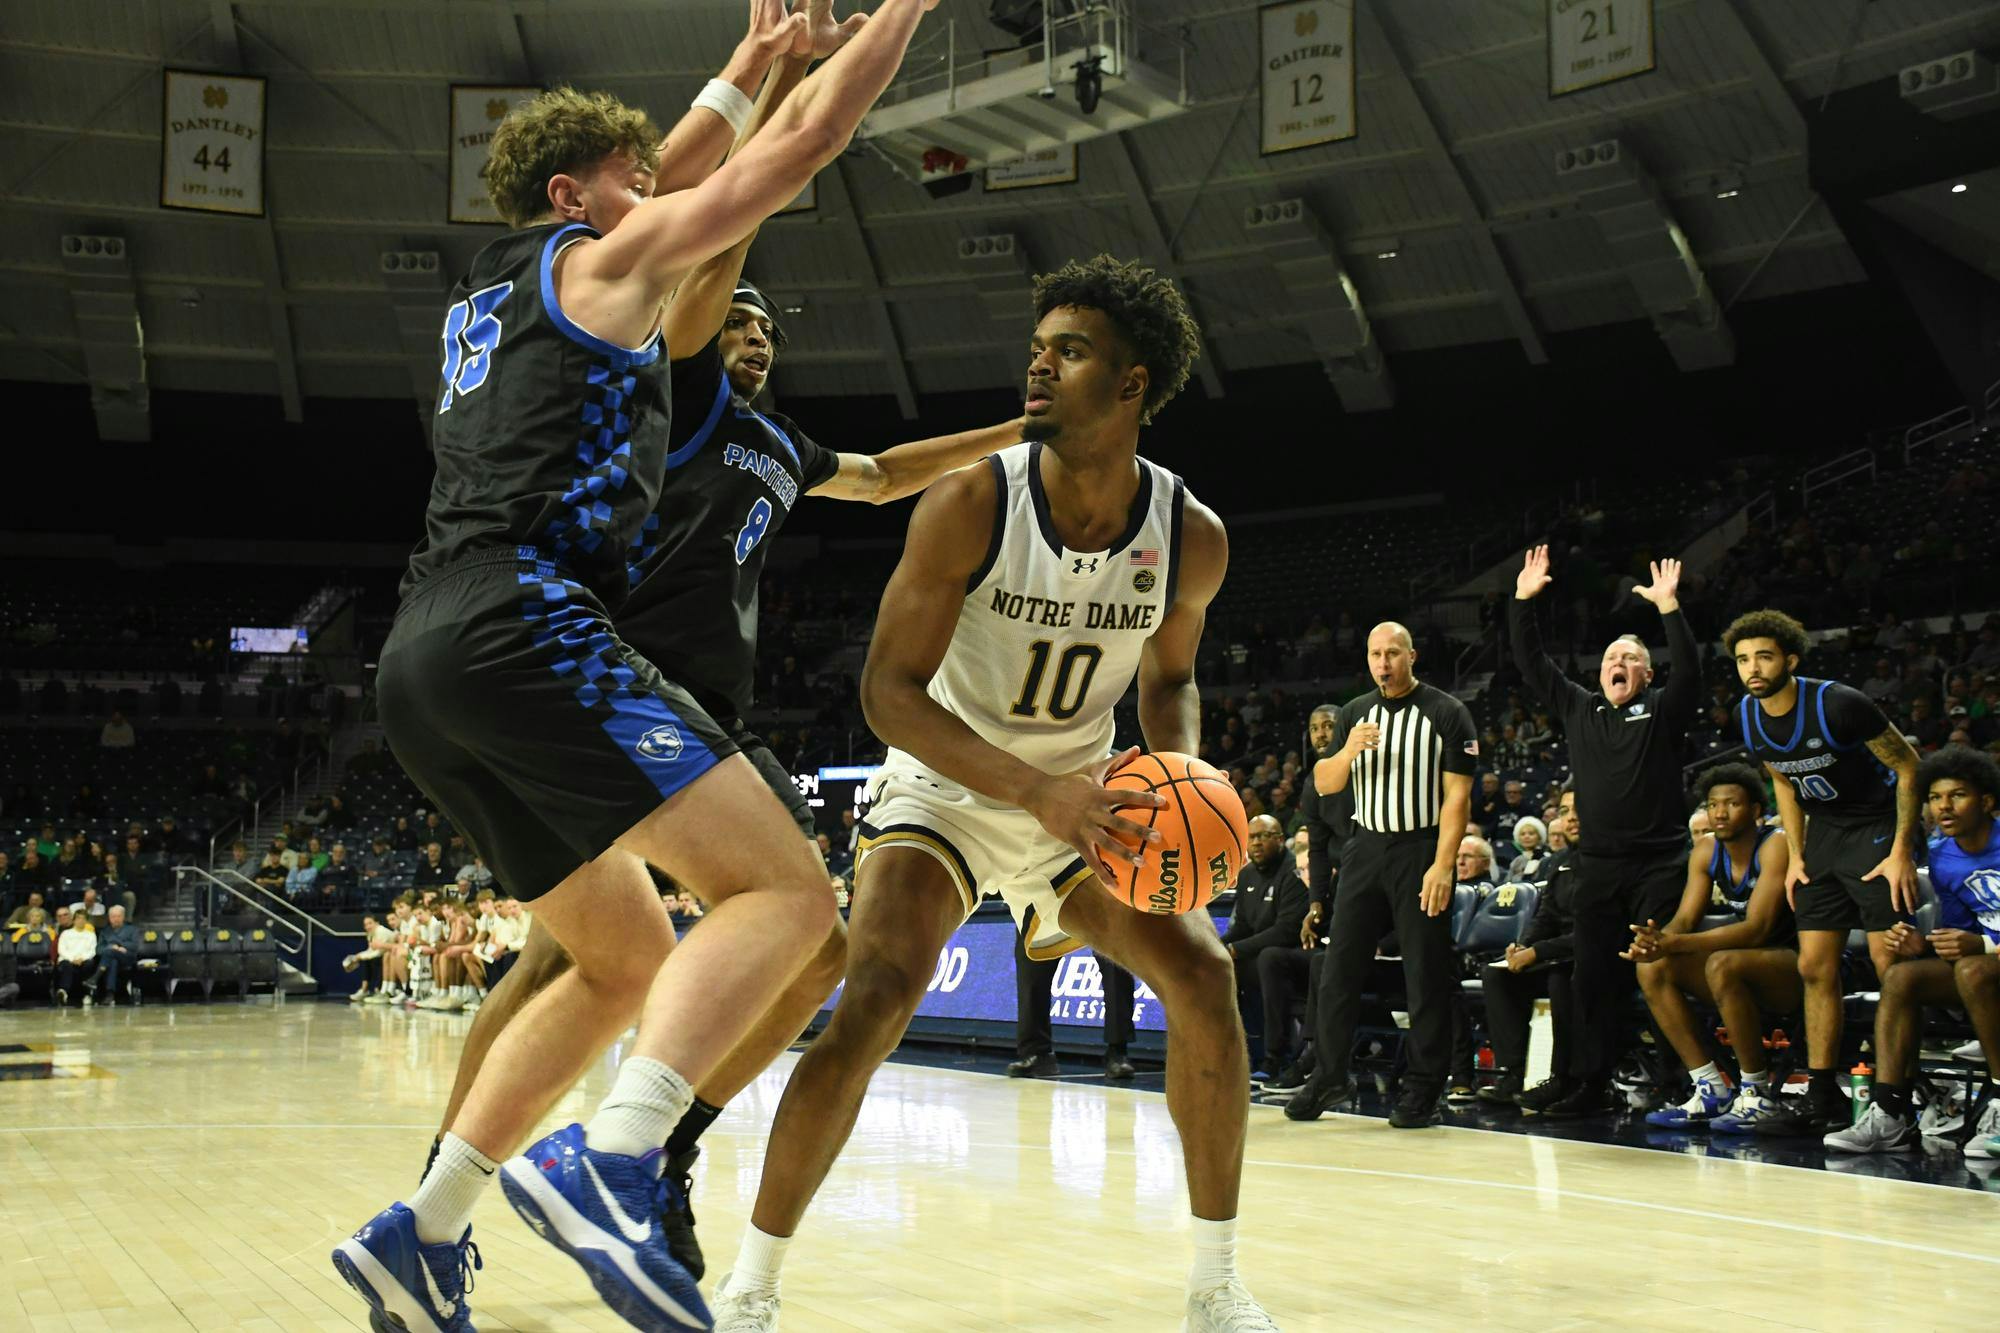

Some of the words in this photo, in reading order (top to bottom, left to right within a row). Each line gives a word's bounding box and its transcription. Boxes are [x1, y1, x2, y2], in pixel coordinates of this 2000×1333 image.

[1580, 3, 1615, 42] 21
[1268, 44, 1343, 71] GAITHER
[1290, 74, 1323, 108] 12
[171, 118, 257, 140] DANTLEY
[193, 144, 232, 174] 44
[439, 280, 513, 415] 15
[735, 496, 772, 566] 8
[990, 588, 1075, 628] NOTRE
[1085, 602, 1156, 630] DAME
[1009, 639, 1104, 721] 10
